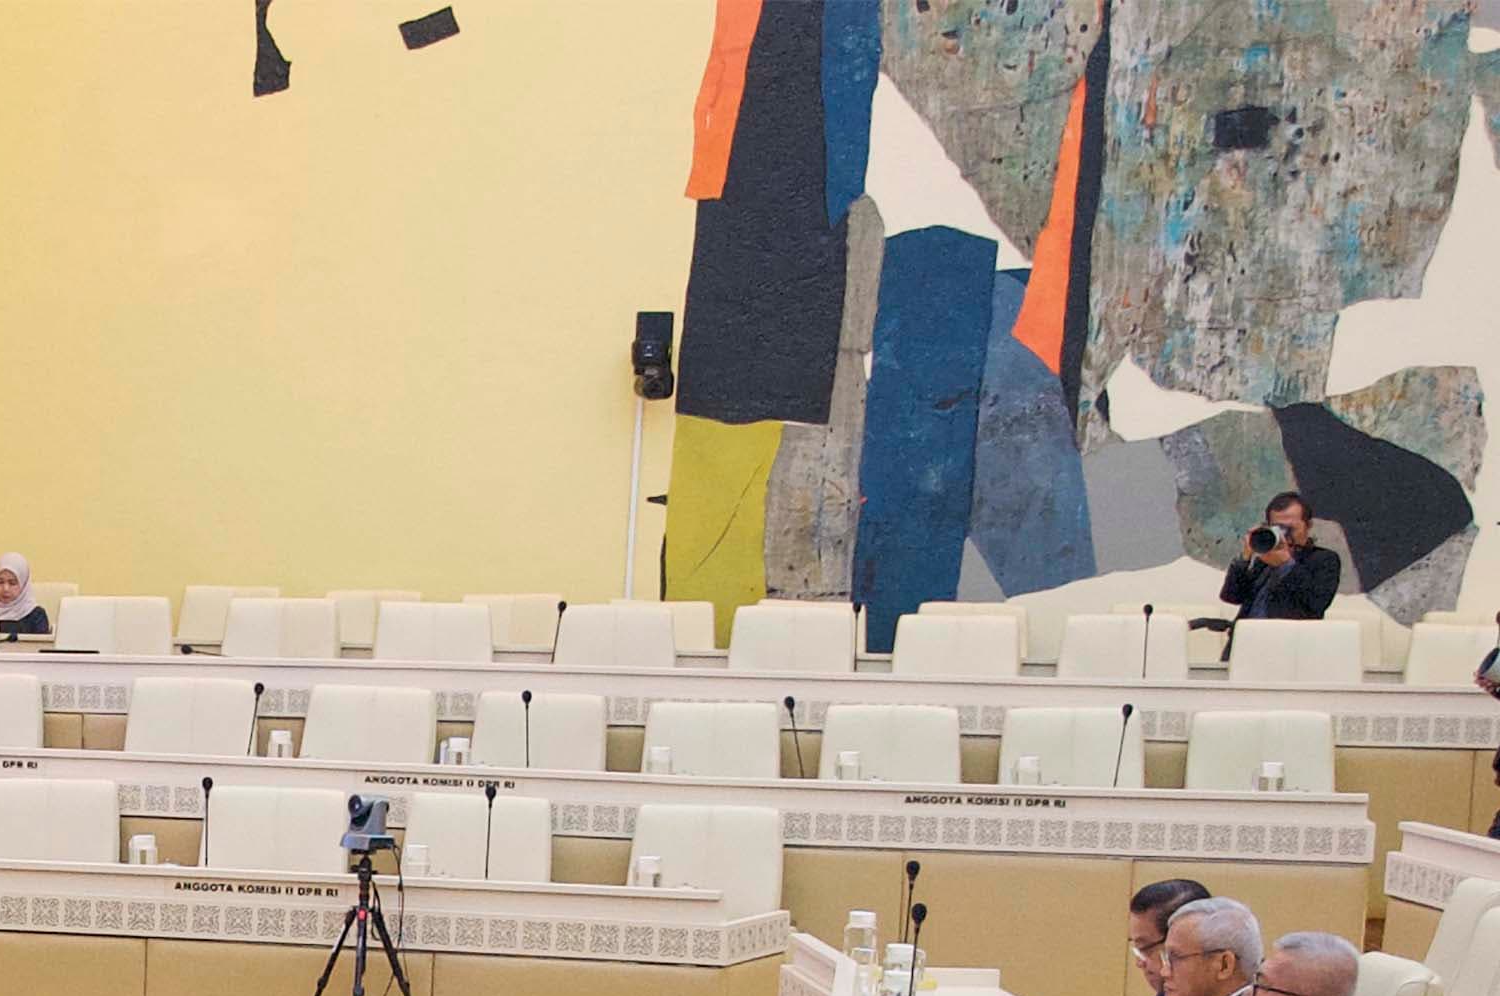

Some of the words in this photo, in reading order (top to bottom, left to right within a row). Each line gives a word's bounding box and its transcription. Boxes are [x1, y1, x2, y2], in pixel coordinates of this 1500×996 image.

[2, 760, 24, 769] DPR
[27, 761, 38, 769] RI
[364, 775, 419, 785] ANGGOTA
[422, 778, 463, 787] KOMISI
[478, 780, 500, 789] DPR
[504, 781, 515, 789] RI
[904, 795, 963, 805] ANGGOTA
[966, 796, 1010, 806] KOMISI
[1025, 799, 1050, 808] DPR
[1053, 799, 1067, 809] RI
[174, 882, 234, 893] ANGGOTA
[237, 884, 282, 895] KOMISI
[297, 887, 322, 897] DPR
[325, 888, 339, 898] RI
